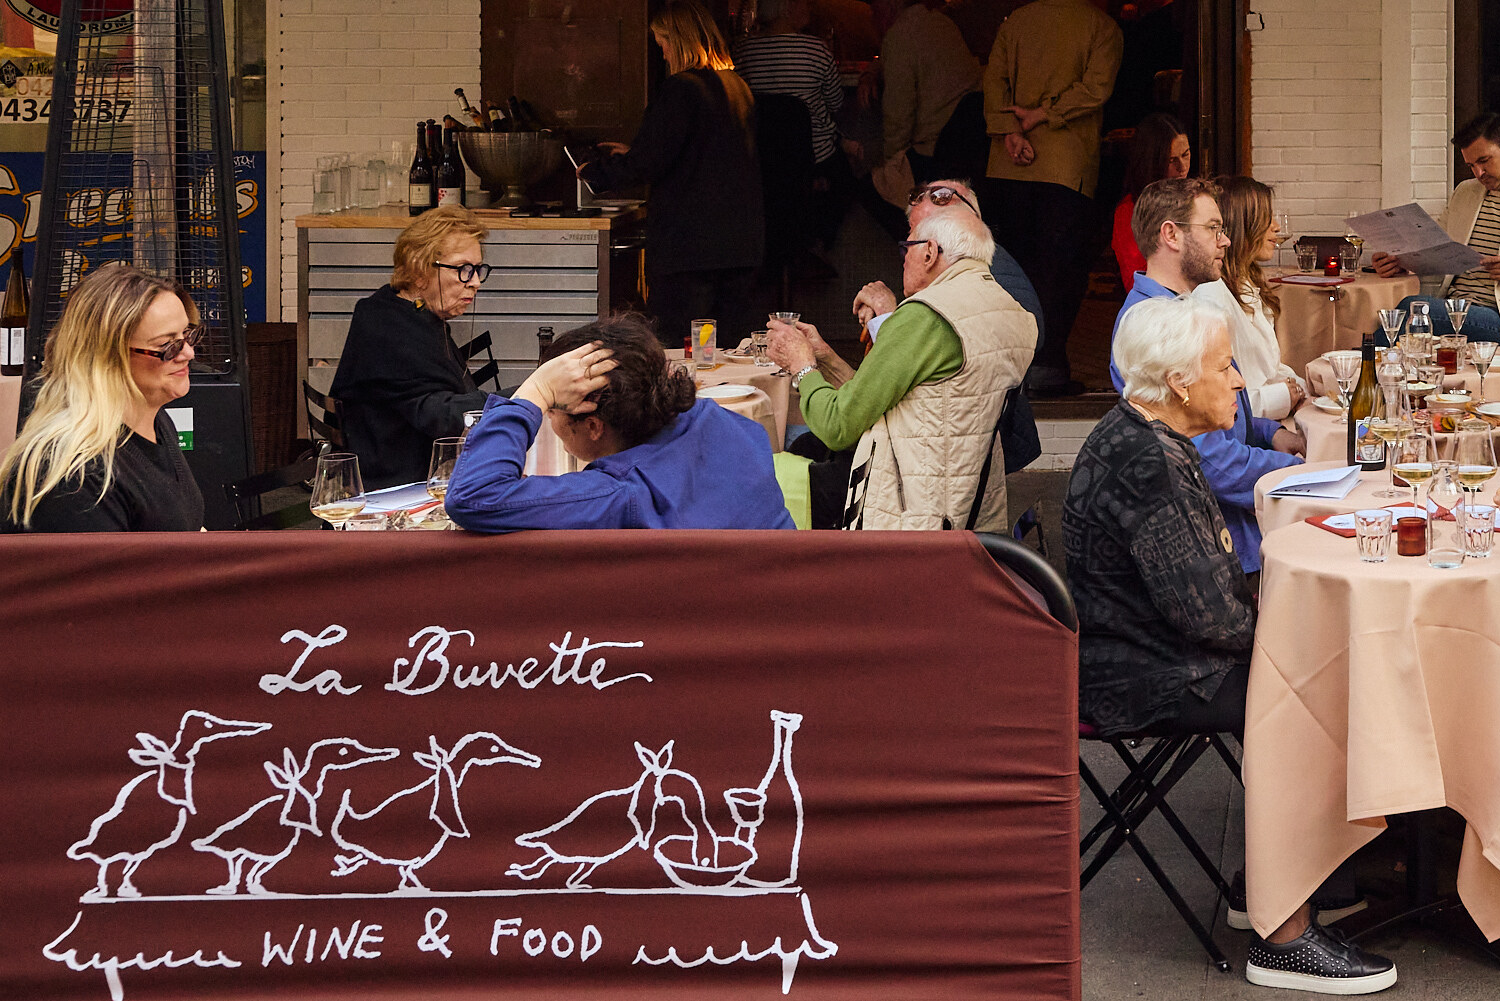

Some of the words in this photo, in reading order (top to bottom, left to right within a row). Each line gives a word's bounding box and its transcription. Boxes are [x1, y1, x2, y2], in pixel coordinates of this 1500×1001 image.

[258, 624, 362, 696] La
[384, 625, 654, 697] Buvette
[262, 919, 385, 965] WINE
[417, 909, 452, 958] &
[489, 917, 603, 960] FOOD
